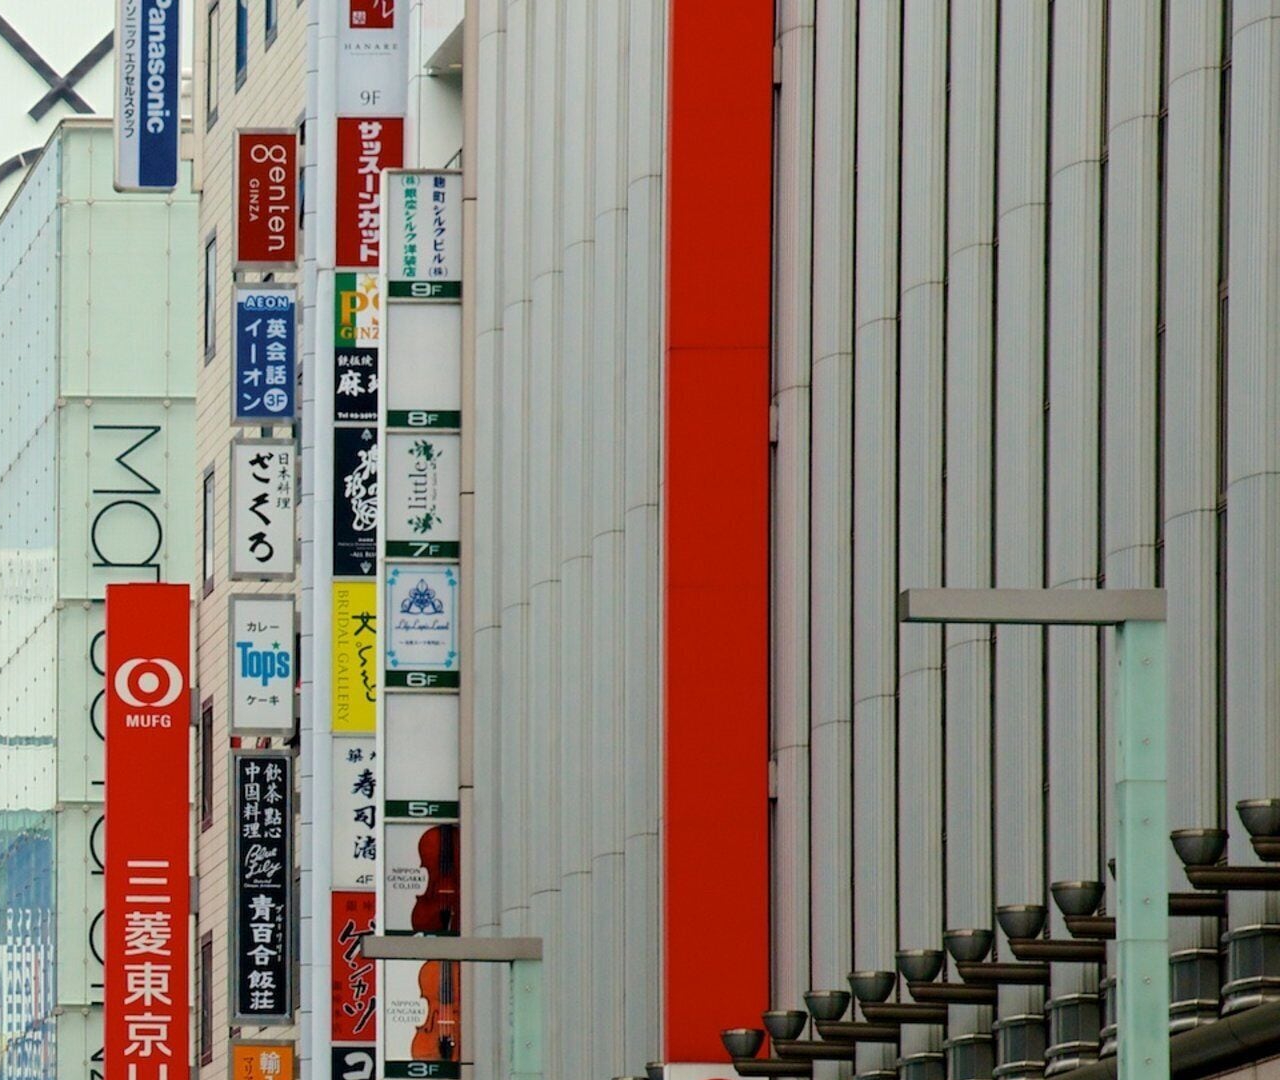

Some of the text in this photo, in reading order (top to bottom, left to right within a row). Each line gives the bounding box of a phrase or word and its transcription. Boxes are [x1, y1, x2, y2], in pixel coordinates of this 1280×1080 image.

[360, 90, 381, 105] 9F
[249, 179, 260, 222] GINZA
[411, 282, 442, 297] 9F
[245, 296, 289, 310] AEON
[266, 318, 287, 385] 英会話
[243, 318, 262, 412] イーオン
[407, 411, 438, 426] 8F
[276, 453, 292, 510] 日本料理
[408, 461, 428, 510] little
[248, 451, 275, 563] ざくろ
[408, 543, 440, 556] 7F
[246, 620, 280, 632] カレー
[406, 672, 437, 686] 6F
[246, 694, 280, 706] ケーキ
[126, 714, 172, 728] MUFG
[408, 802, 440, 816] 5F
[407, 1062, 439, 1077] 3F
